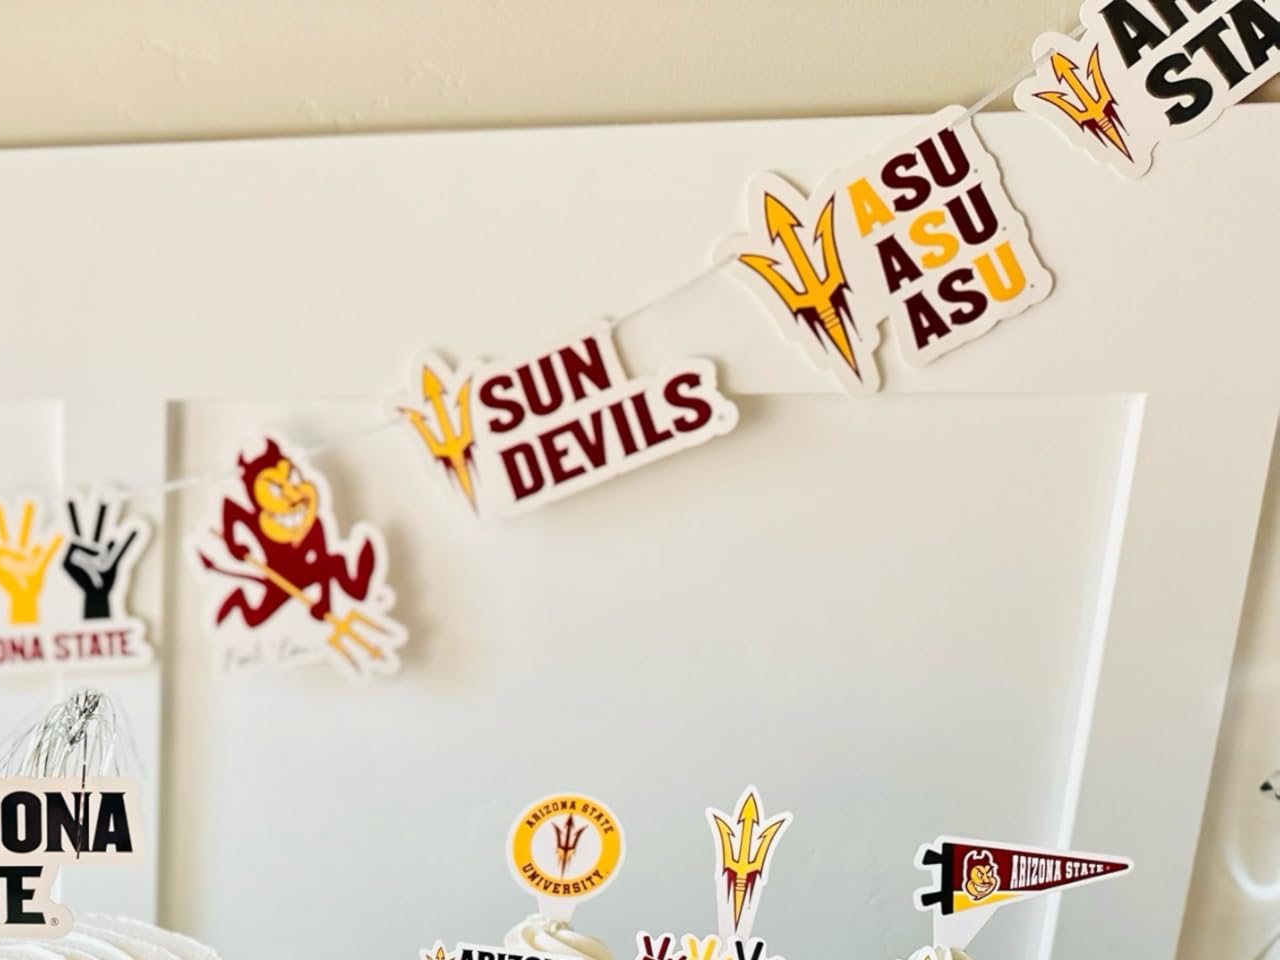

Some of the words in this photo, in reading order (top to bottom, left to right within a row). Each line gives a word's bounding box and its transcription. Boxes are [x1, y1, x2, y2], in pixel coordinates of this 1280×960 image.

[847, 127, 971, 238] ASU
[875, 182, 999, 294] ASU
[904, 240, 1026, 350] ASU
[479, 336, 612, 433] SUN
[499, 373, 712, 501] DEVILS
[53, 629, 134, 660] STATE
[526, 800, 576, 828] ARIZONA
[581, 804, 615, 834] STATE
[522, 863, 604, 894] UNIVERSITY
[1010, 855, 1061, 889] ARIZONA
[1065, 862, 1104, 879] STATE
